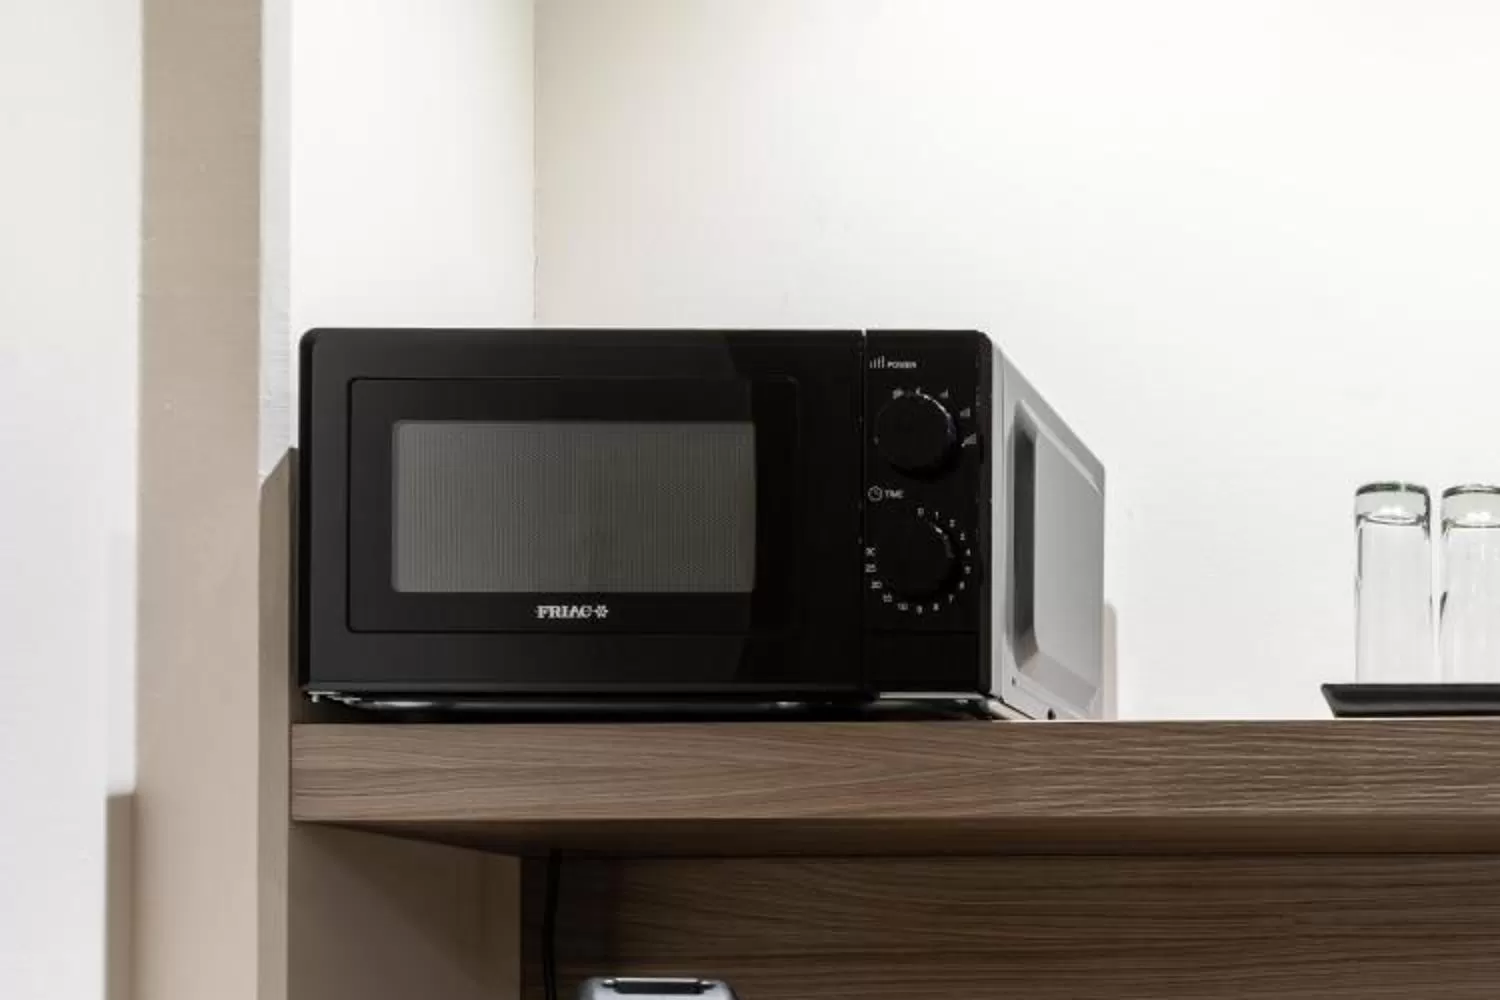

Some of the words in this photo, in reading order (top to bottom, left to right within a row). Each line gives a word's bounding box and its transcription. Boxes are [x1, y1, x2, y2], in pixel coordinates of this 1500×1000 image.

[887, 360, 917, 369] POWER
[884, 489, 904, 499] TIME
[536, 604, 593, 619] FRIAC
